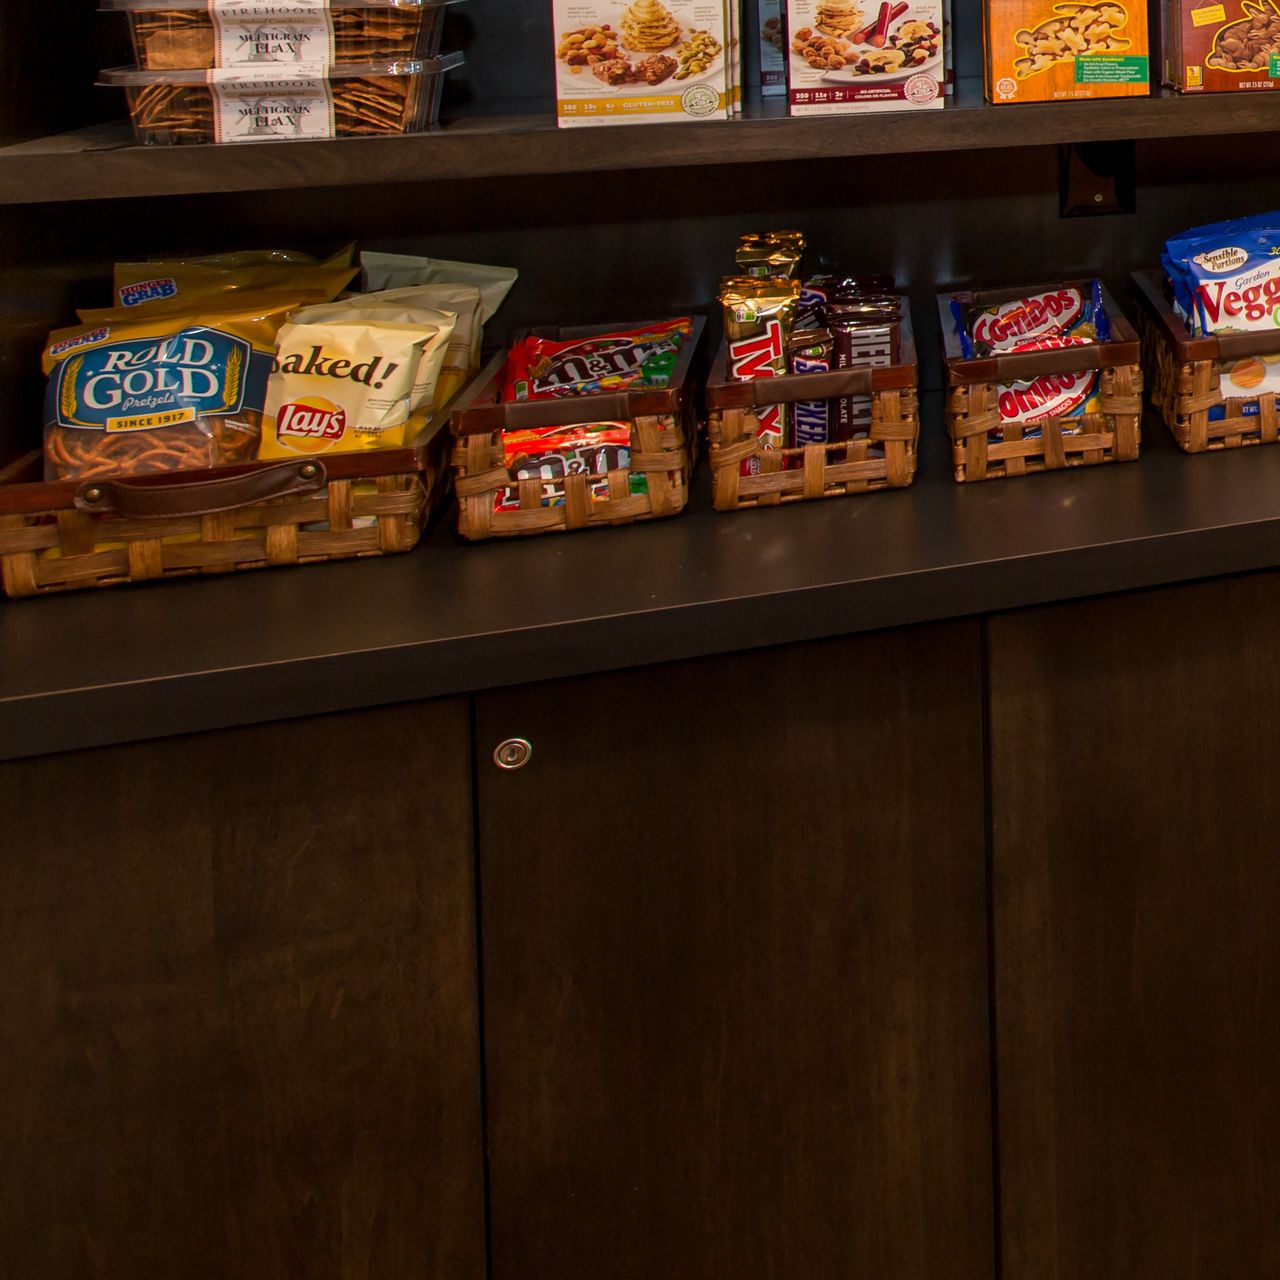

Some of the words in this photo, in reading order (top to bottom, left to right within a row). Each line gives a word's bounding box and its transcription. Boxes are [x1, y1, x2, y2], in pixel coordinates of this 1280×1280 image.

[239, 33, 311, 43] MULTIGRAIN
[239, 106, 311, 116] MULTIGRAIN
[1203, 248, 1238, 264] Sensible
[1211, 255, 1245, 270] Portions
[1234, 270, 1270, 290] Garden
[101, 339, 216, 372] ROLD
[83, 370, 220, 410] GOLD
[116, 416, 154, 430] SINCE
[157, 412, 186, 426] 1917
